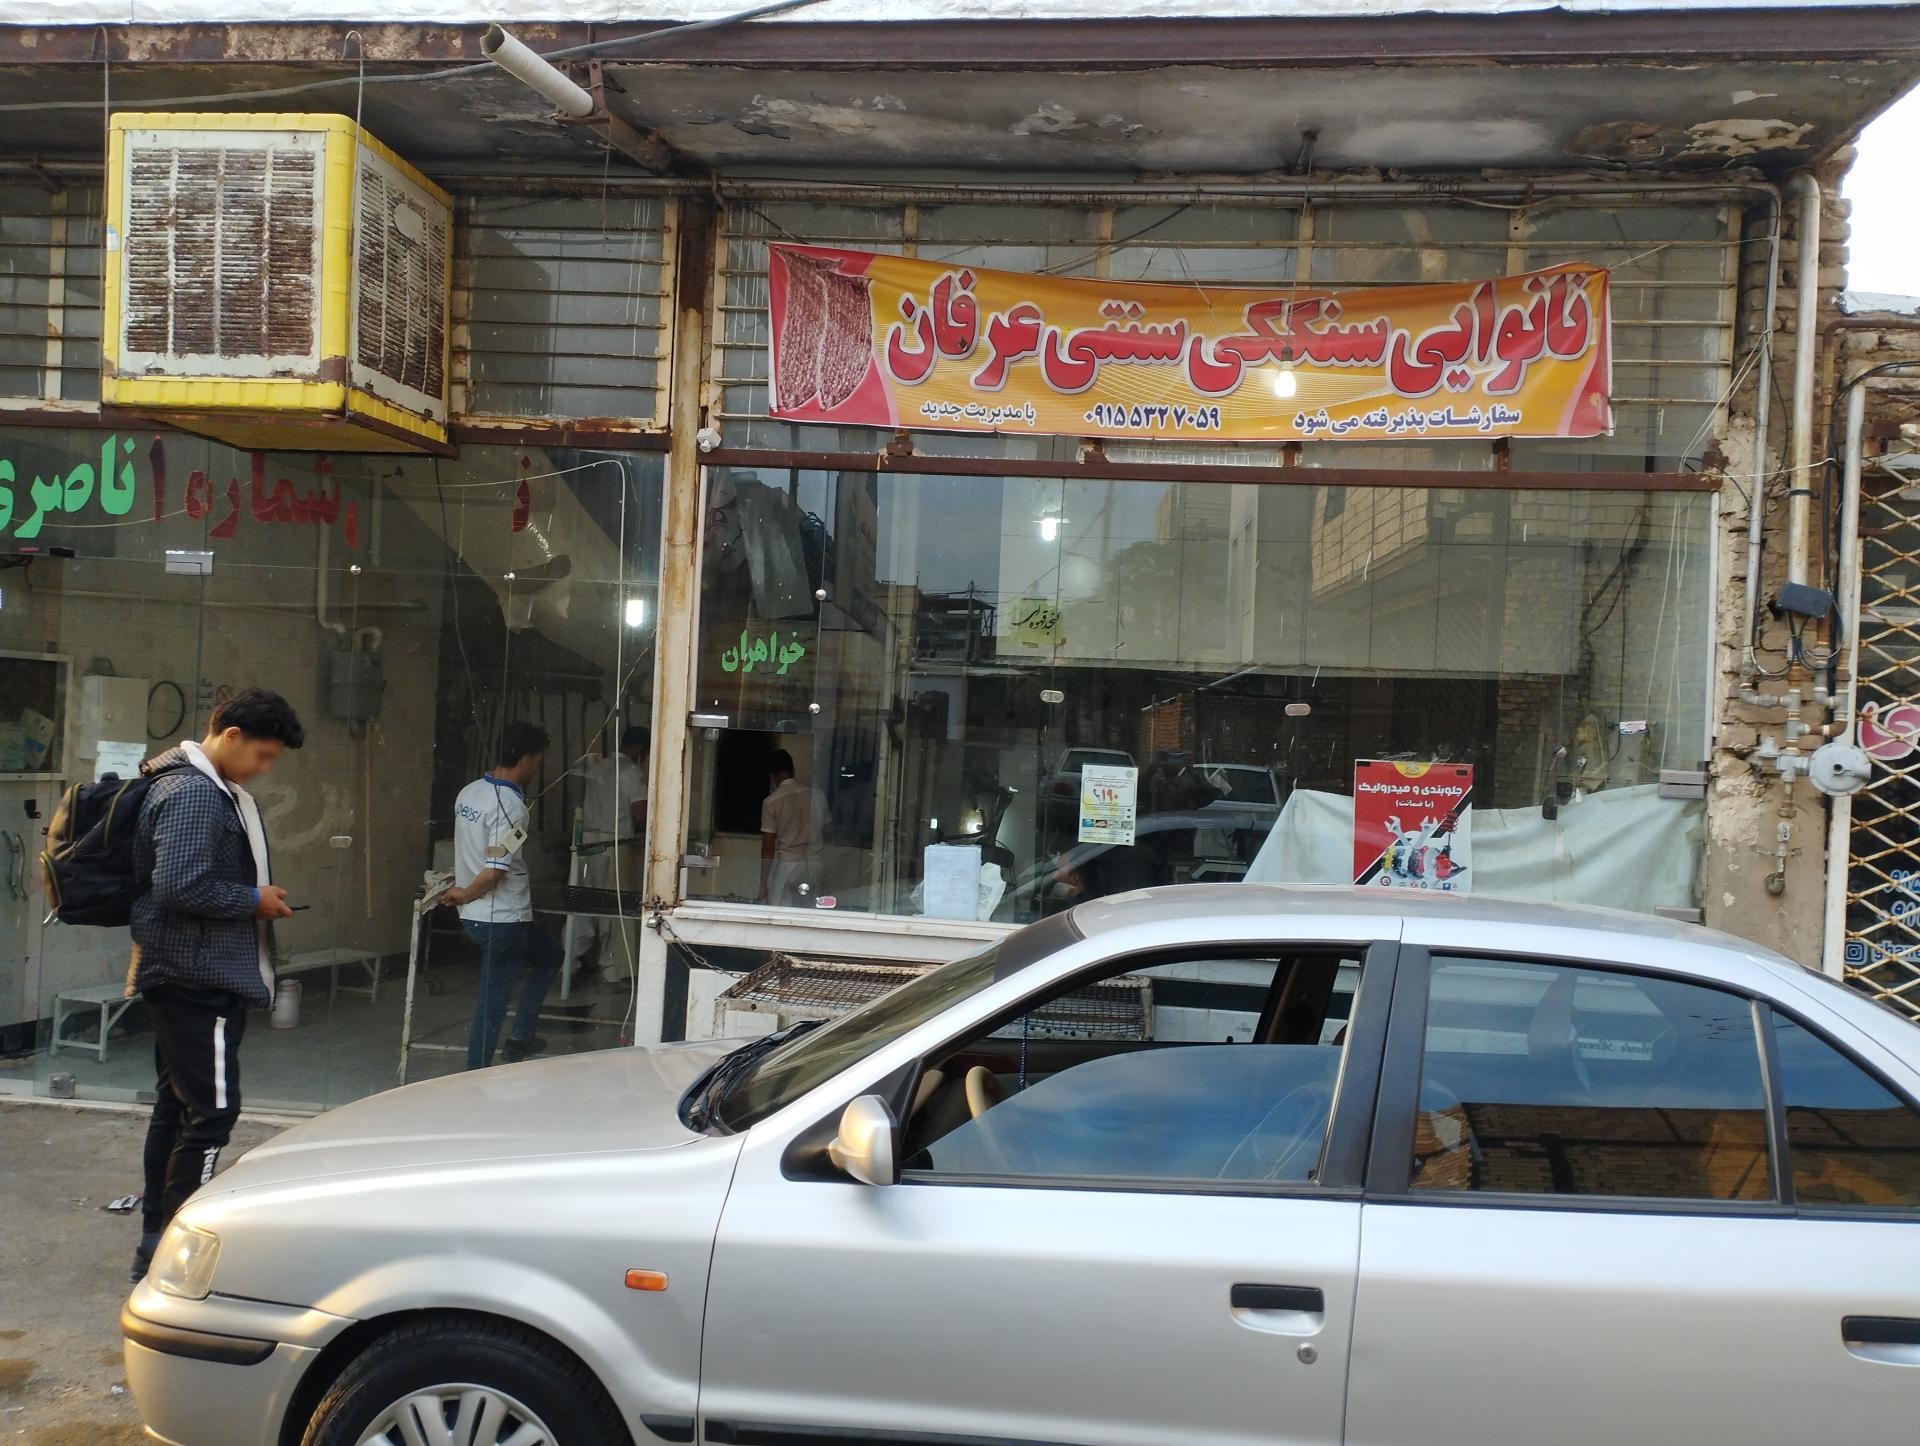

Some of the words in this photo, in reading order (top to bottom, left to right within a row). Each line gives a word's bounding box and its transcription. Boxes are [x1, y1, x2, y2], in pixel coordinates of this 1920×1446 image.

[886, 268, 1042, 390] عرفان
[1389, 272, 1590, 395] نانوایی
[1042, 300, 1188, 392] سنتی
[921, 402, 961, 421] جدید
[965, 402, 1024, 425] مدیریت
[1025, 402, 1036, 426] با
[1294, 409, 1329, 434] شود
[1362, 406, 1425, 434] پذیرفته
[1429, 404, 1521, 432] سفارشات
[1330, 414, 1360, 434] می
[721, 628, 806, 676] خواهران
[1101, 788, 1119, 802] ۱۹۰
[1358, 782, 1411, 793] هیدرولیک
[1412, 784, 1419, 795] و
[1421, 785, 1463, 797] جلوبندی
